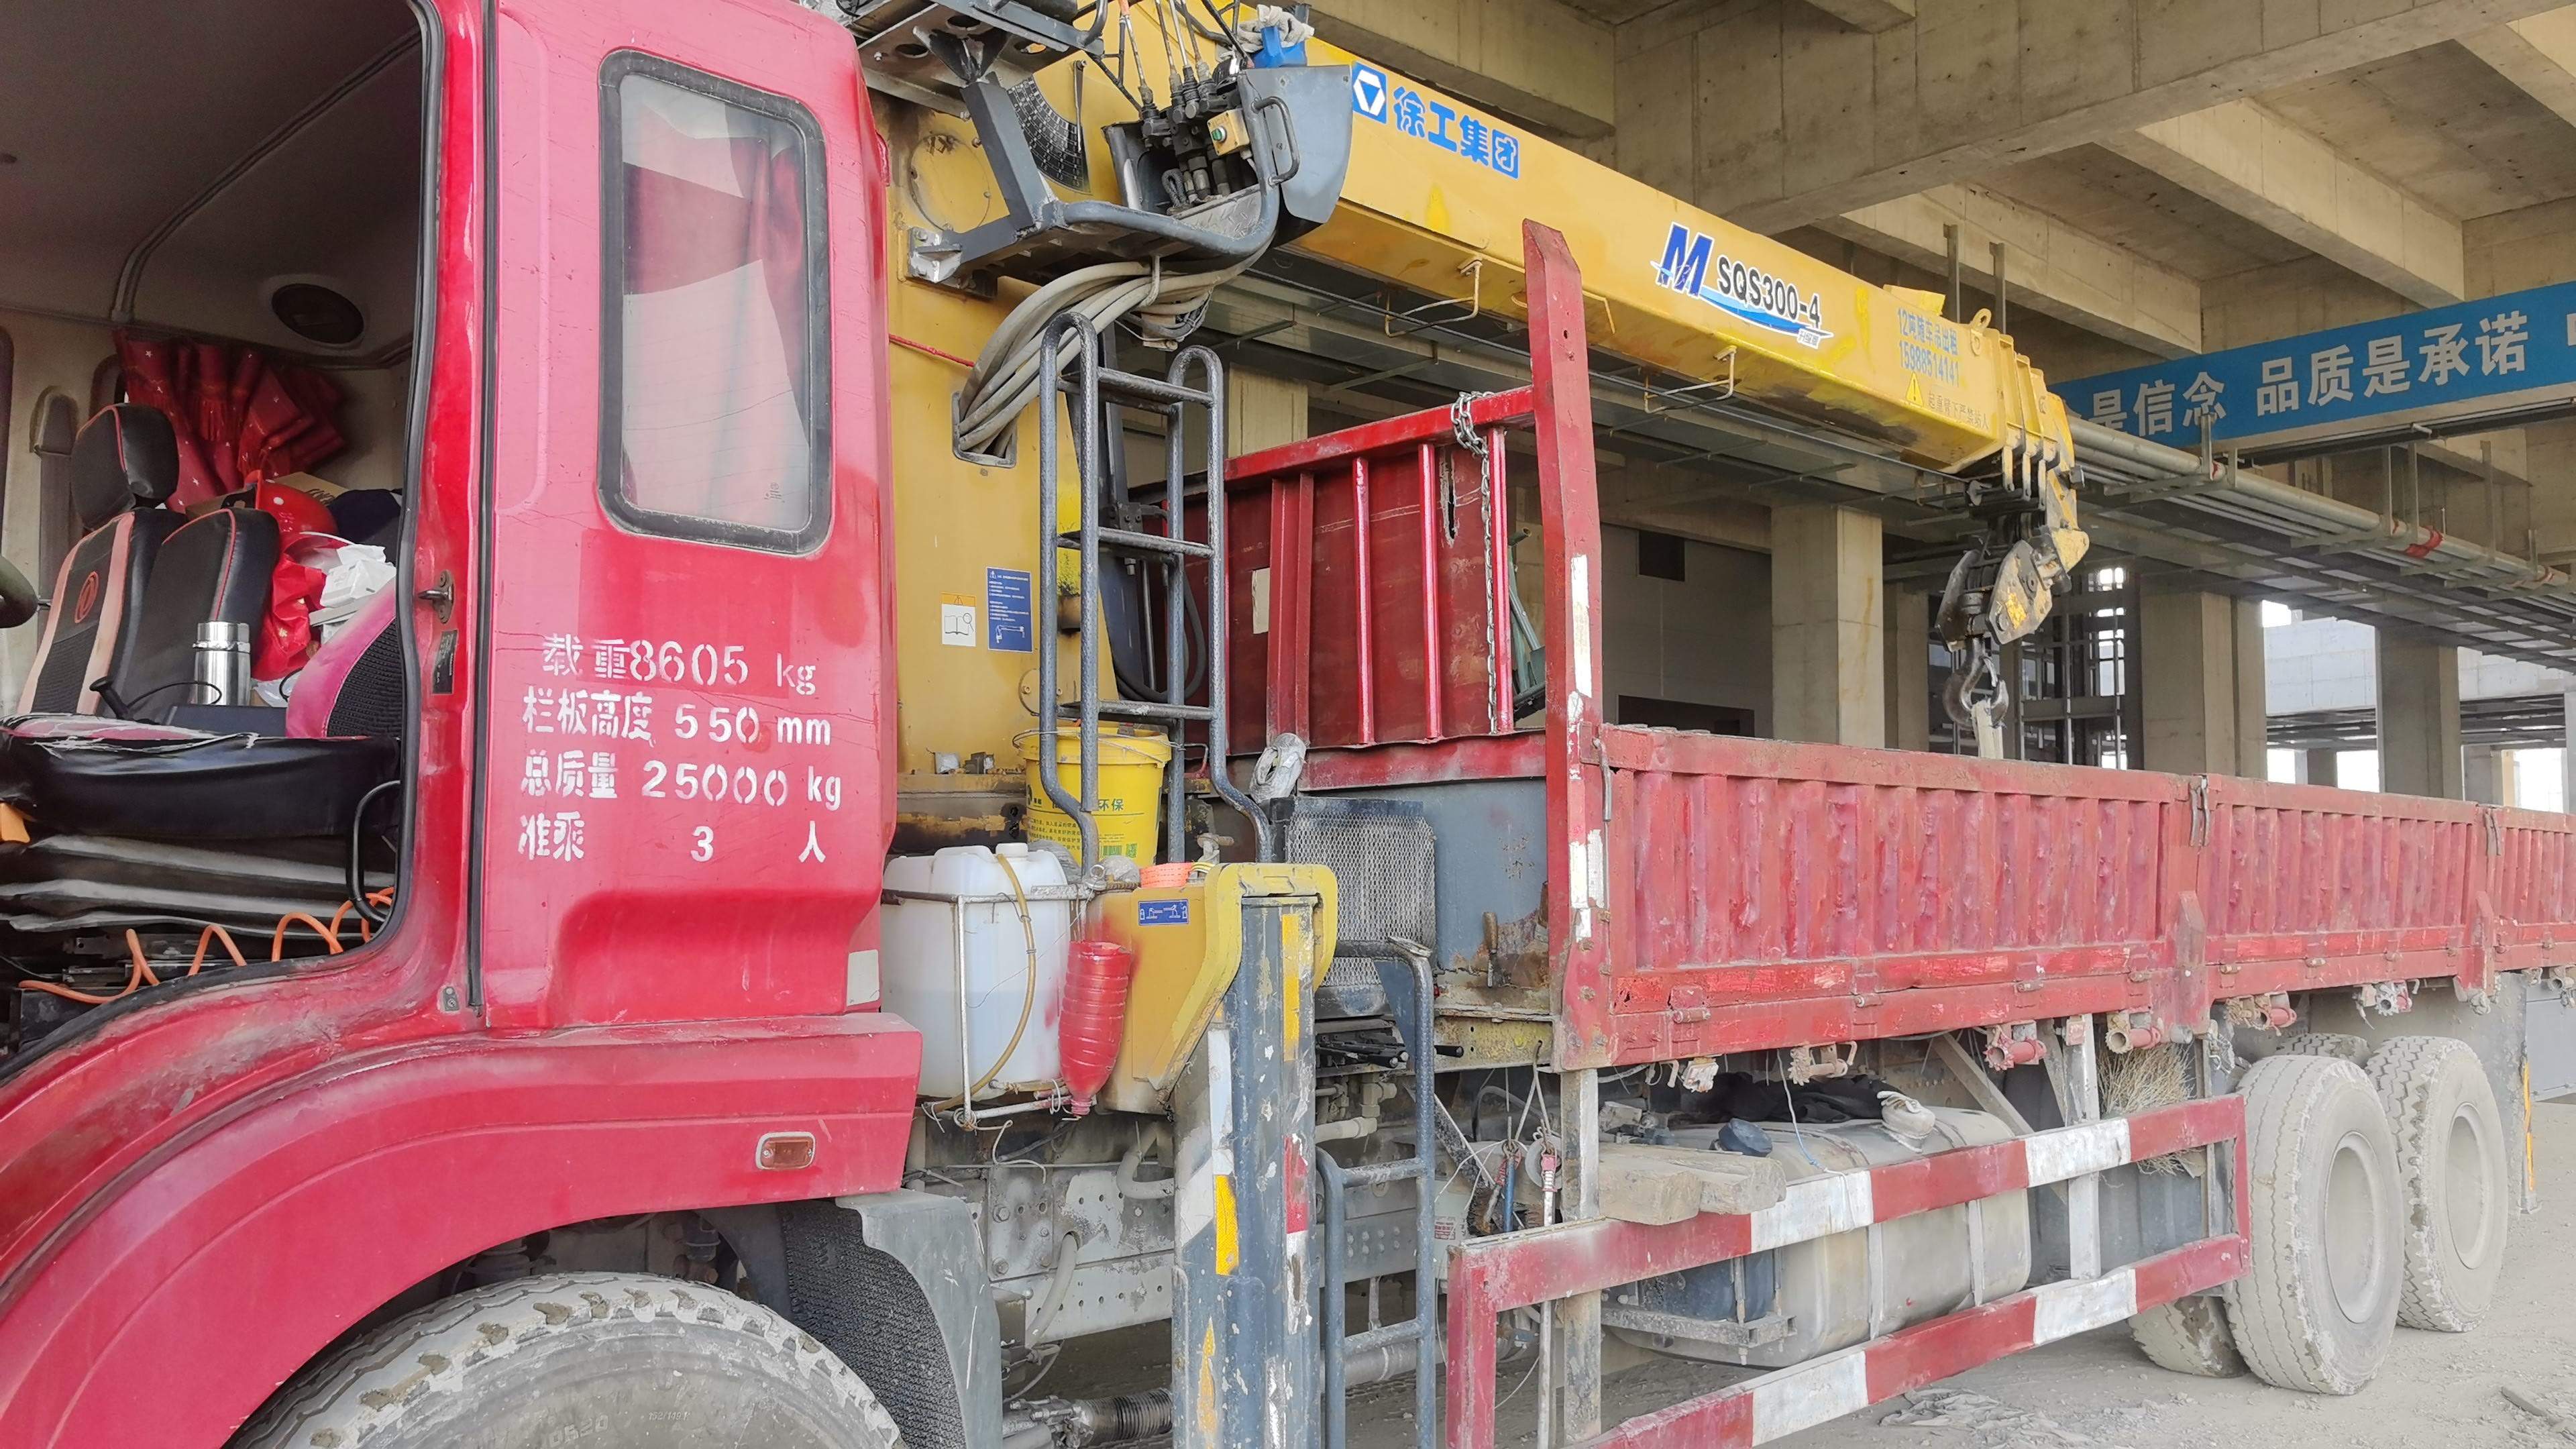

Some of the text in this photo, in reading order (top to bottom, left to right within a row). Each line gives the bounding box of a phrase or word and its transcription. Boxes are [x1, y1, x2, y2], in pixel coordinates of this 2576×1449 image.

[1393, 86, 1520, 179] 徐工集团
[1719, 256, 1820, 329] SQS300-4
[2065, 309, 2529, 437] 是信念 品质是承诺
[776, 653, 816, 696] kg
[523, 686, 831, 746] 栏板高度 550 mm
[520, 749, 842, 811] 总质量 25000 kg
[518, 811, 826, 863] 准乘 3 人
